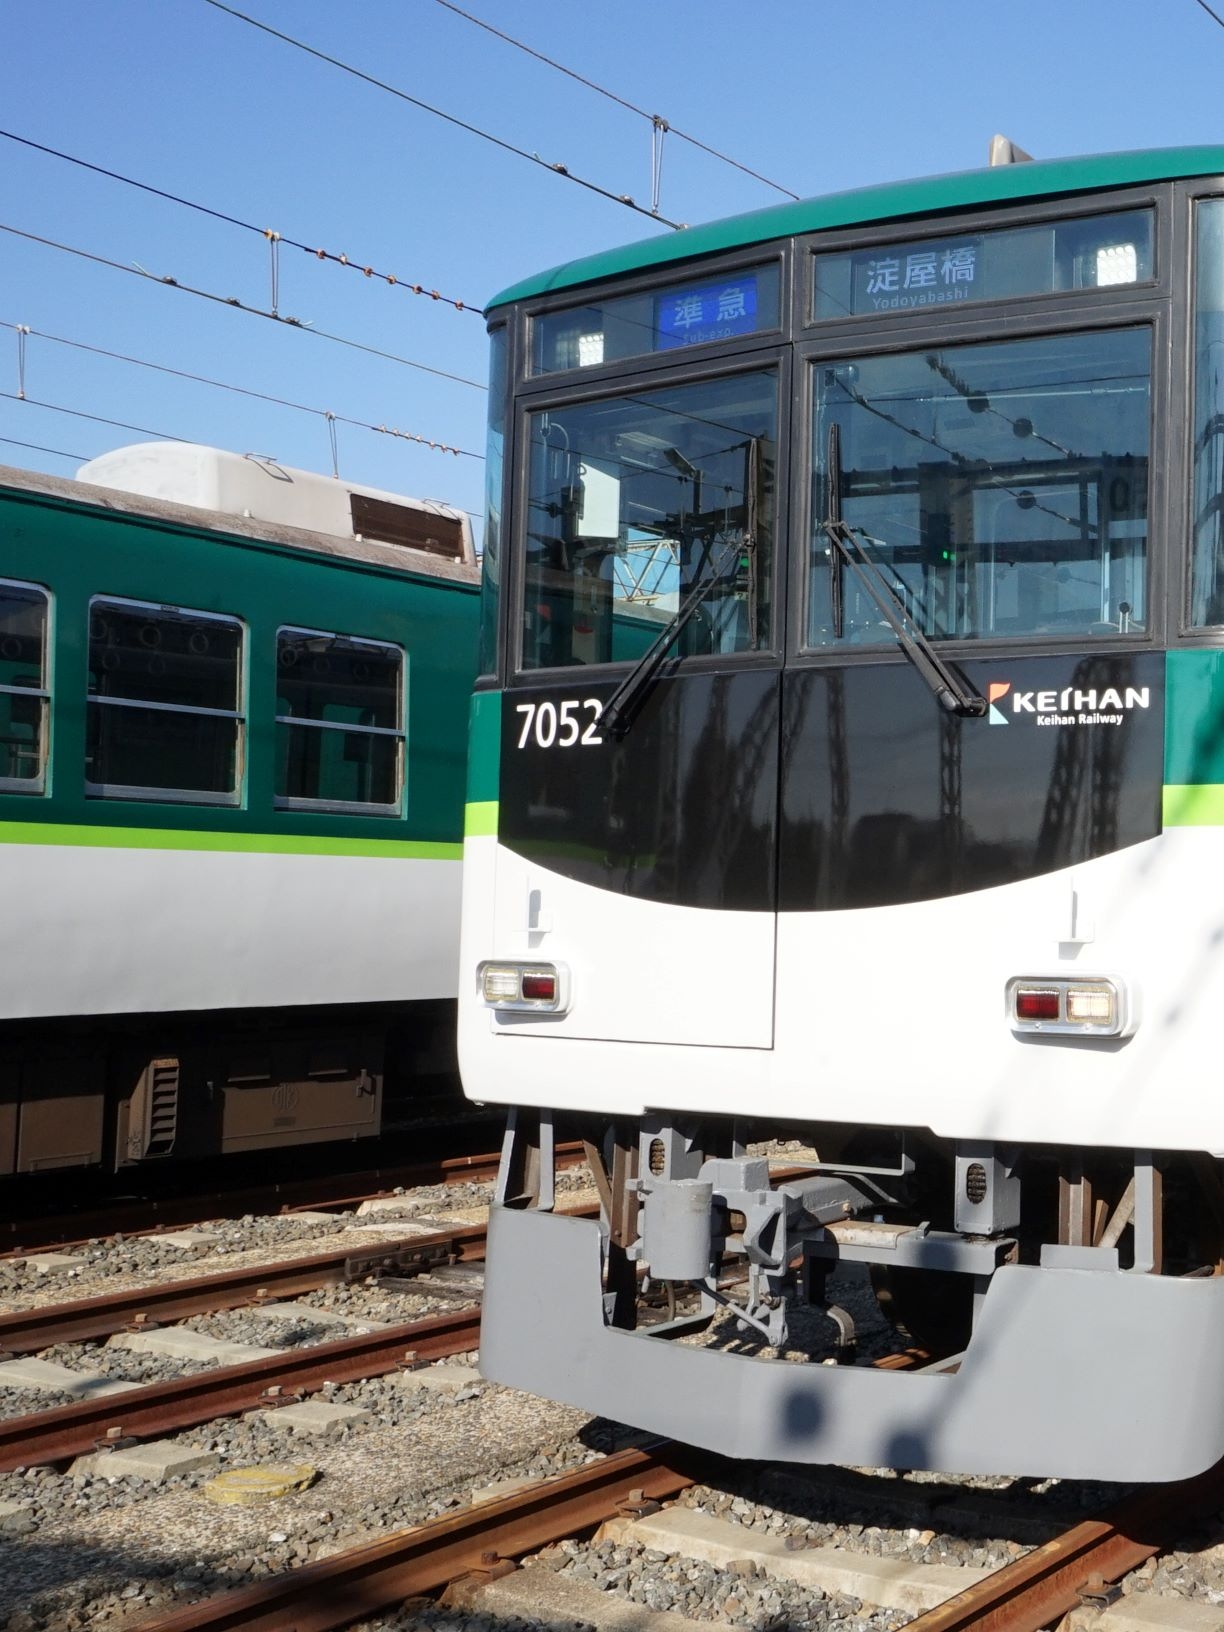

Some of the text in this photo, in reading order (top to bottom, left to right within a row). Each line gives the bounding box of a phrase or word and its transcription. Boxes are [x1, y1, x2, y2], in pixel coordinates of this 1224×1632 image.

[866, 246, 976, 294] 淀屋橋
[872, 286, 969, 310] Yodoyabashi
[1013, 687, 1150, 713] KEIHAN
[516, 698, 603, 749] 7052
[1037, 713, 1123, 726] Keihan Railway
